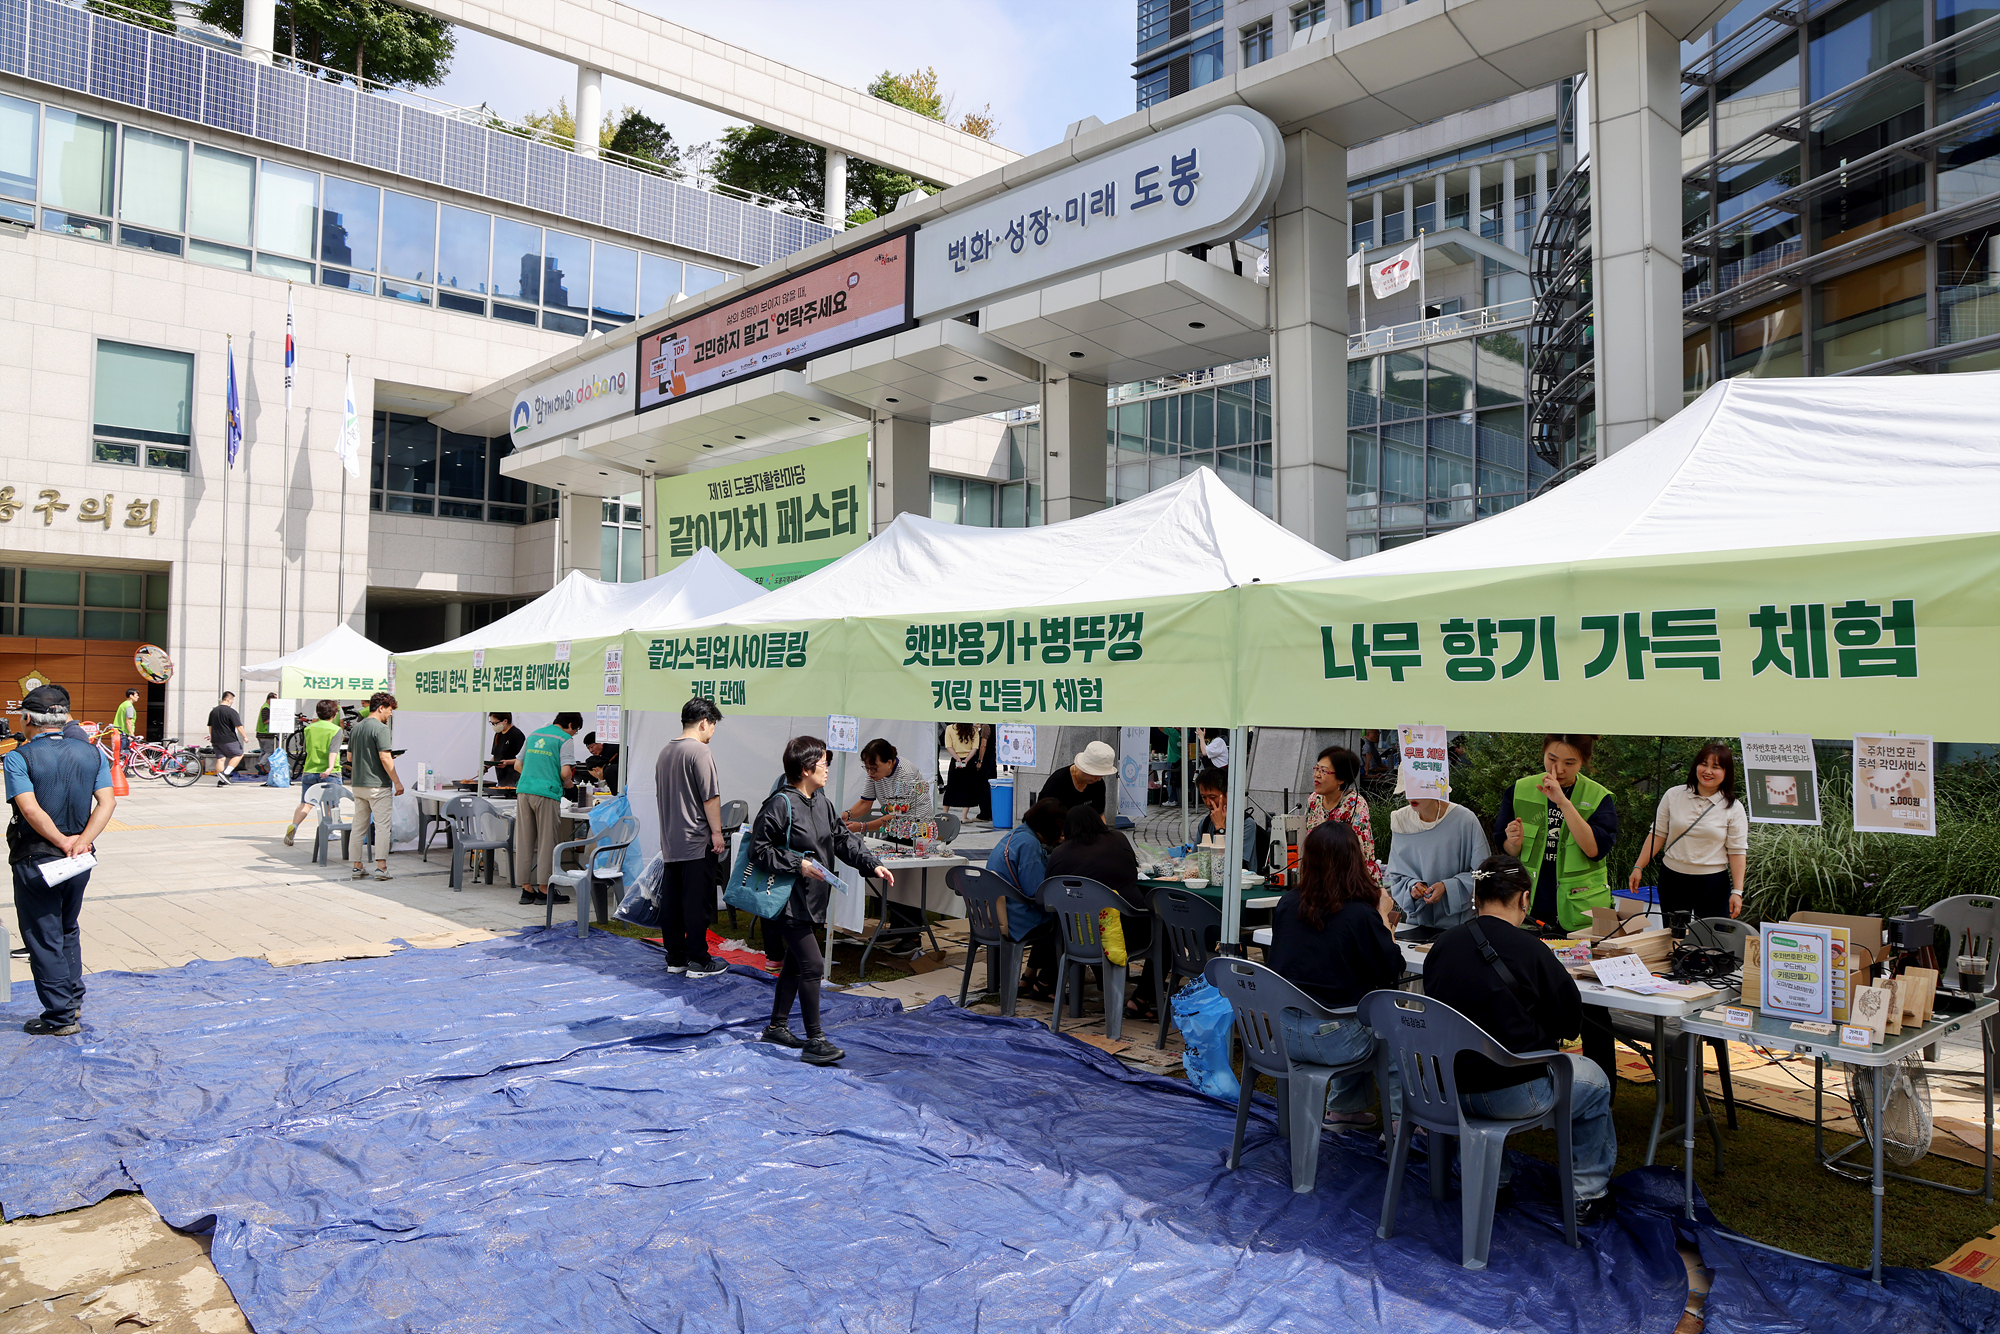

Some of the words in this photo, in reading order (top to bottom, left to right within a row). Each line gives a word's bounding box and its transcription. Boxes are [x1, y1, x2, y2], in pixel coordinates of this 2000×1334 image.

[948, 181, 1117, 273] 변화·성장·미래
[1130, 148, 1201, 210] 도봉
[761, 296, 781, 315] 보이지
[782, 290, 796, 304] 않을
[693, 329, 740, 364] 고민하지
[743, 318, 769, 347] 말고
[776, 290, 848, 335] 연락주세요
[673, 344, 685, 356] 109
[576, 371, 626, 404] dobong
[707, 479, 733, 501] 제1회
[734, 464, 806, 497] 도봉자활한마당
[669, 502, 768, 558] 같이가치
[776, 484, 859, 545] 페스타
[903, 611, 1144, 667] 햇반용기+병뚜껑
[1320, 620, 1423, 682] 나무
[1440, 614, 1561, 682] 향기
[1581, 608, 1722, 681] 가득
[1749, 599, 1919, 679] 체험
[647, 630, 809, 670] 플라스틱업사이클링
[303, 676, 344, 690] 자전거
[348, 677, 374, 690] 무료
[415, 670, 447, 694] 우리동네
[449, 668, 469, 694] 한식,
[472, 667, 491, 693] 분식
[493, 664, 522, 692] 전문점
[525, 661, 570, 691] 함께밥상
[691, 680, 715, 702] 키링
[719, 678, 747, 707] 판매
[931, 680, 972, 712] 키링
[979, 678, 1046, 713] 만들기
[1052, 676, 1104, 713] 체험
[1404, 747, 1424, 760] 무료
[1426, 747, 1446, 761] 체험
[1745, 743, 1777, 753] 주차번호판
[1778, 744, 1792, 754] 즉석
[1793, 745, 1807, 754] 각인
[1867, 745, 1916, 758] 주차번호판
[1412, 761, 1443, 772] 우드키링
[1858, 757, 1876, 769] 즉석
[1879, 759, 1927, 772] 각인서비스
[1889, 796, 1928, 808] 5,000원에
[1891, 809, 1929, 821] 해드립니다
[1773, 952, 1802, 961] 주차번호판
[1803, 953, 1816, 962] 각인
[1783, 962, 1807, 972] 우드버닝
[1777, 971, 1811, 981] 키링만들기
